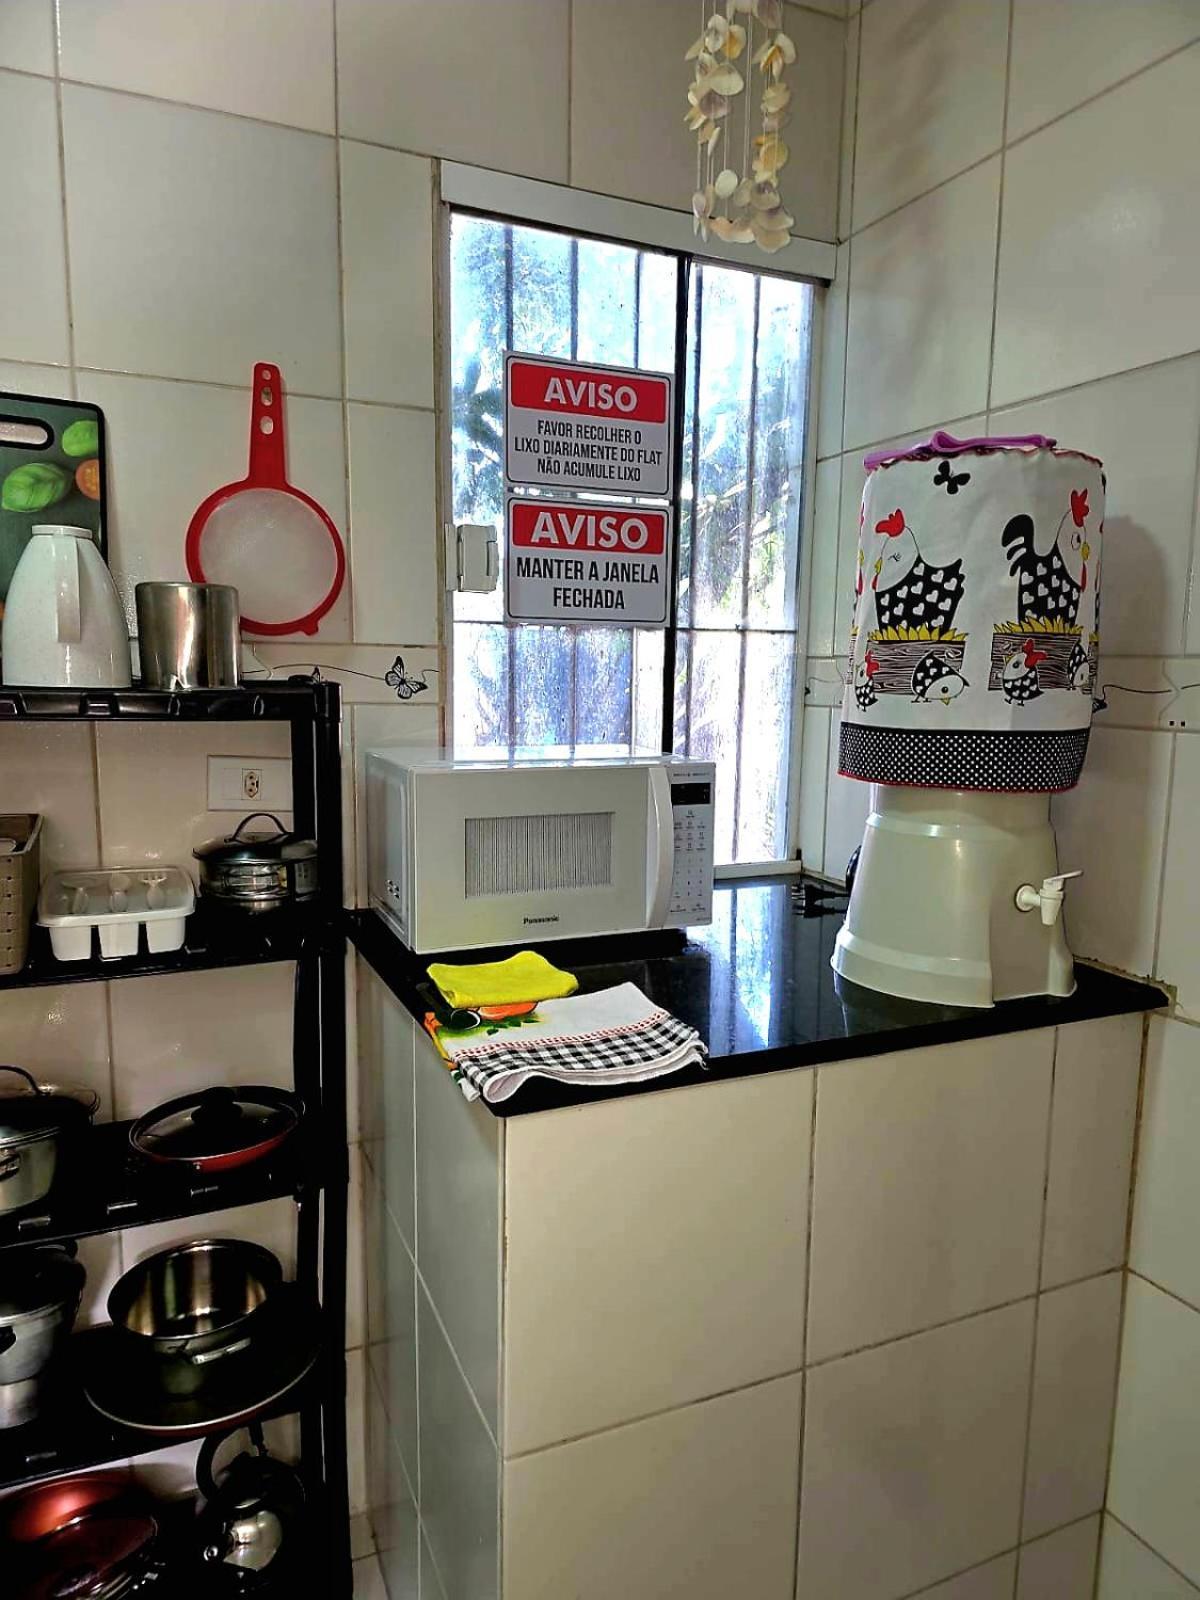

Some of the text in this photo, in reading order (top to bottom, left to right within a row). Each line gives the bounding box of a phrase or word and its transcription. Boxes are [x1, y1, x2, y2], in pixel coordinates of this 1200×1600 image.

[544, 377, 638, 412] AVISO
[537, 420, 641, 444] FAVOR RECOLHER O
[514, 437, 663, 465] LIXO DIARIAMENTE DO FLAT
[537, 457, 640, 482] NÃO ACUMULE LIXO
[531, 511, 649, 550] AVISO
[516, 557, 659, 584] MANTER A JANELA
[553, 587, 625, 610] FECHADA
